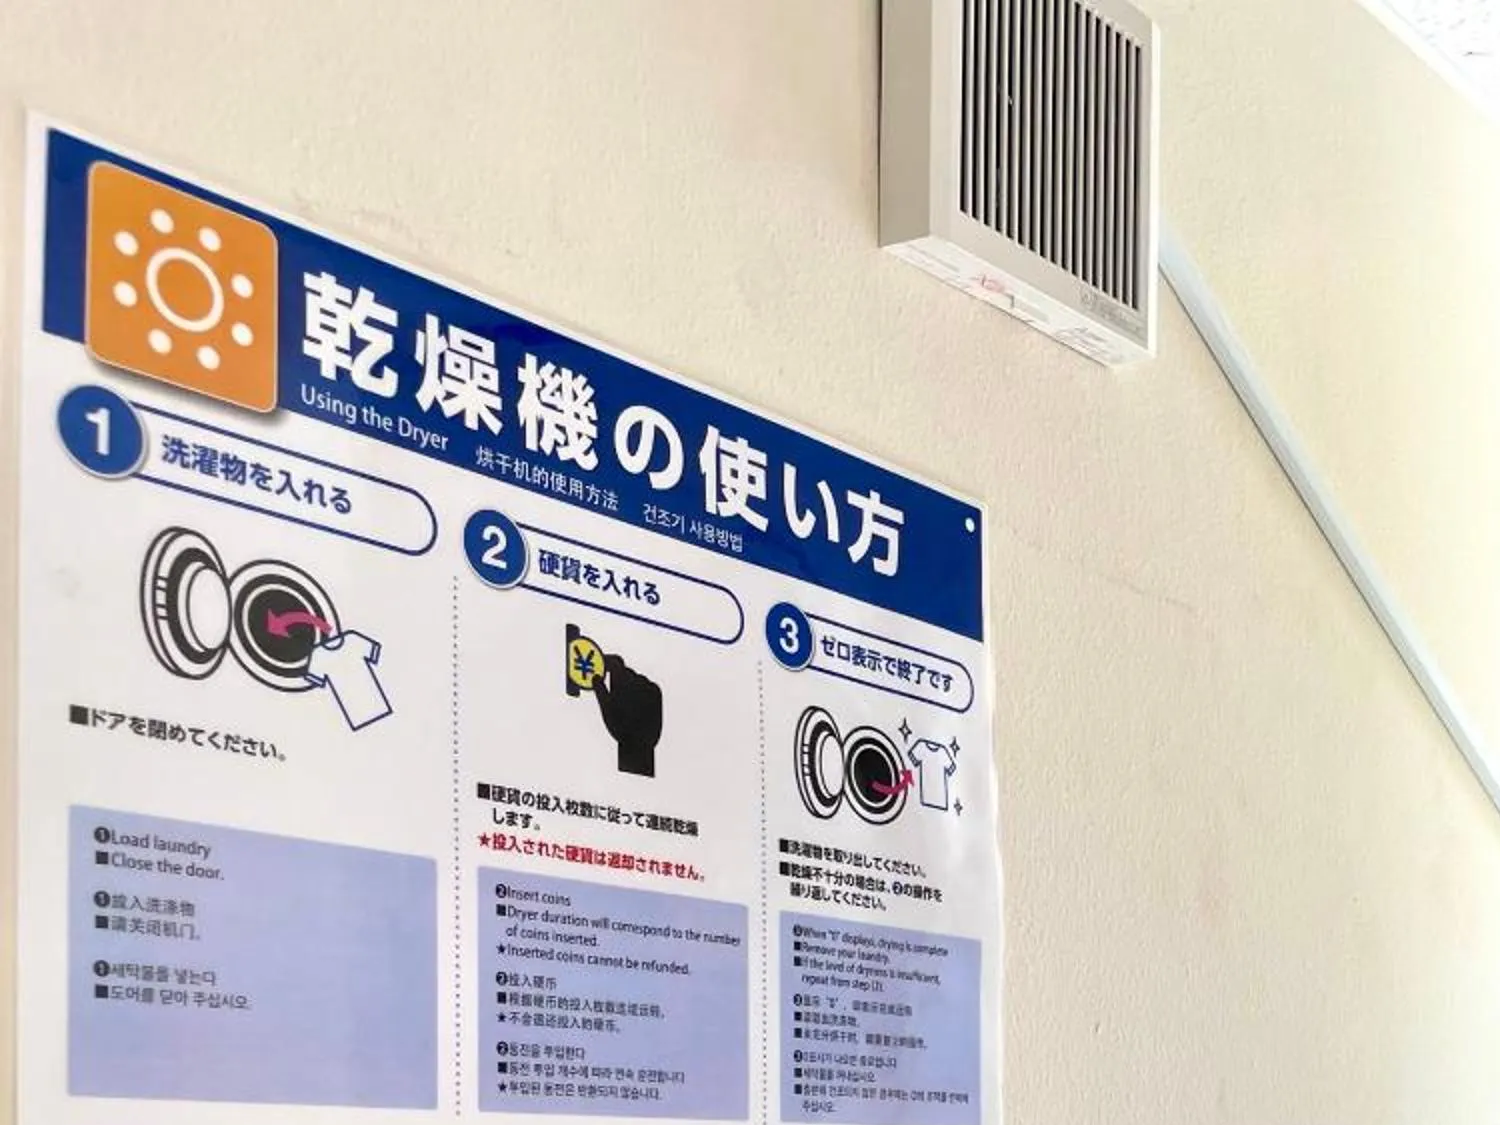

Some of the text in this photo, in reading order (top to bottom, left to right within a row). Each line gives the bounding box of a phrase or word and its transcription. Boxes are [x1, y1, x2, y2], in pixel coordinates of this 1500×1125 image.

[87, 407, 110, 455] 1
[300, 383, 449, 451] Using the Dryer
[303, 271, 906, 579] 乾燥機の使い方
[161, 433, 352, 515] 洗濯物を入れる
[475, 443, 620, 512] 烘干机的使用方法
[481, 526, 507, 570] 2
[642, 502, 744, 552] 건조기 사용방법
[538, 548, 662, 606] 硬貨を入れる
[779, 616, 799, 655] 3
[820, 635, 954, 694] ゼロ表示で終了です
[91, 708, 286, 762] ドアを閉めてください。
[111, 829, 211, 860] Load laundry
[493, 807, 541, 831] します。
[111, 852, 152, 871] Close
[157, 857, 183, 875] the
